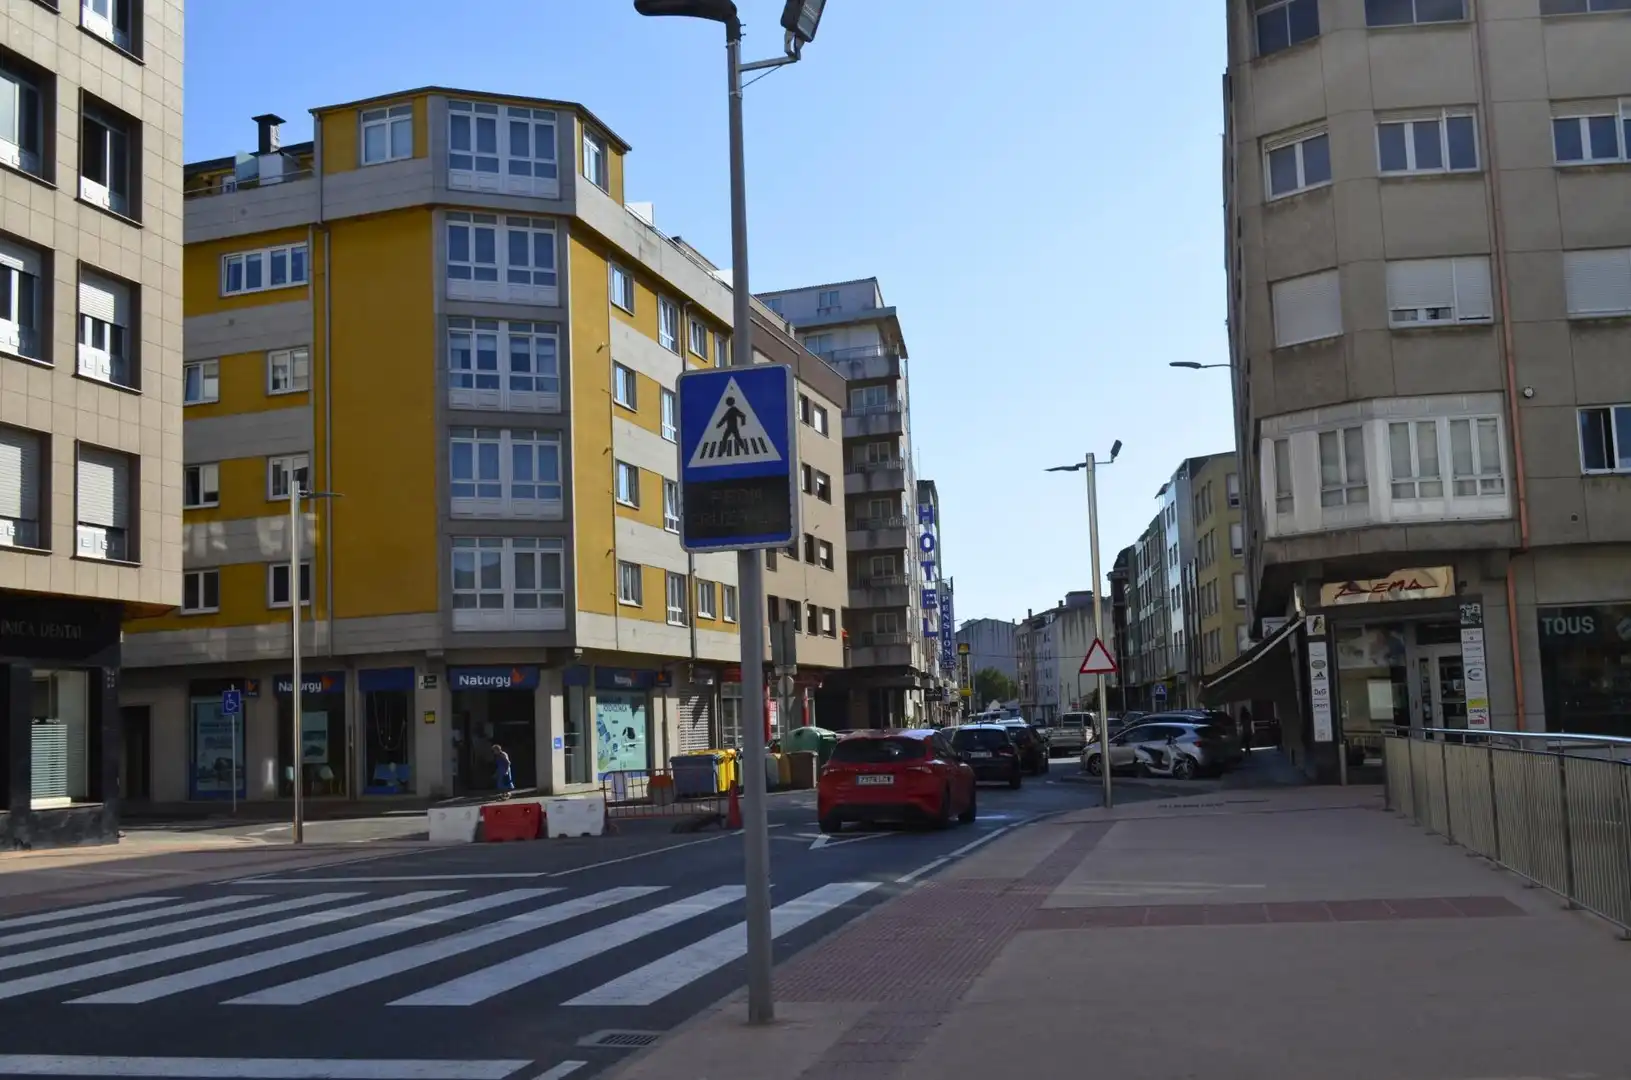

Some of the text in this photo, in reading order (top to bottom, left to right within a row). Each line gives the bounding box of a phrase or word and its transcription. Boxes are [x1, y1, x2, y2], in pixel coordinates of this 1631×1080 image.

[919, 504, 939, 637] HOTEL
[1541, 615, 1596, 636] TOUS
[278, 681, 322, 693] Naurgy
[458, 675, 511, 689] Naturgy
